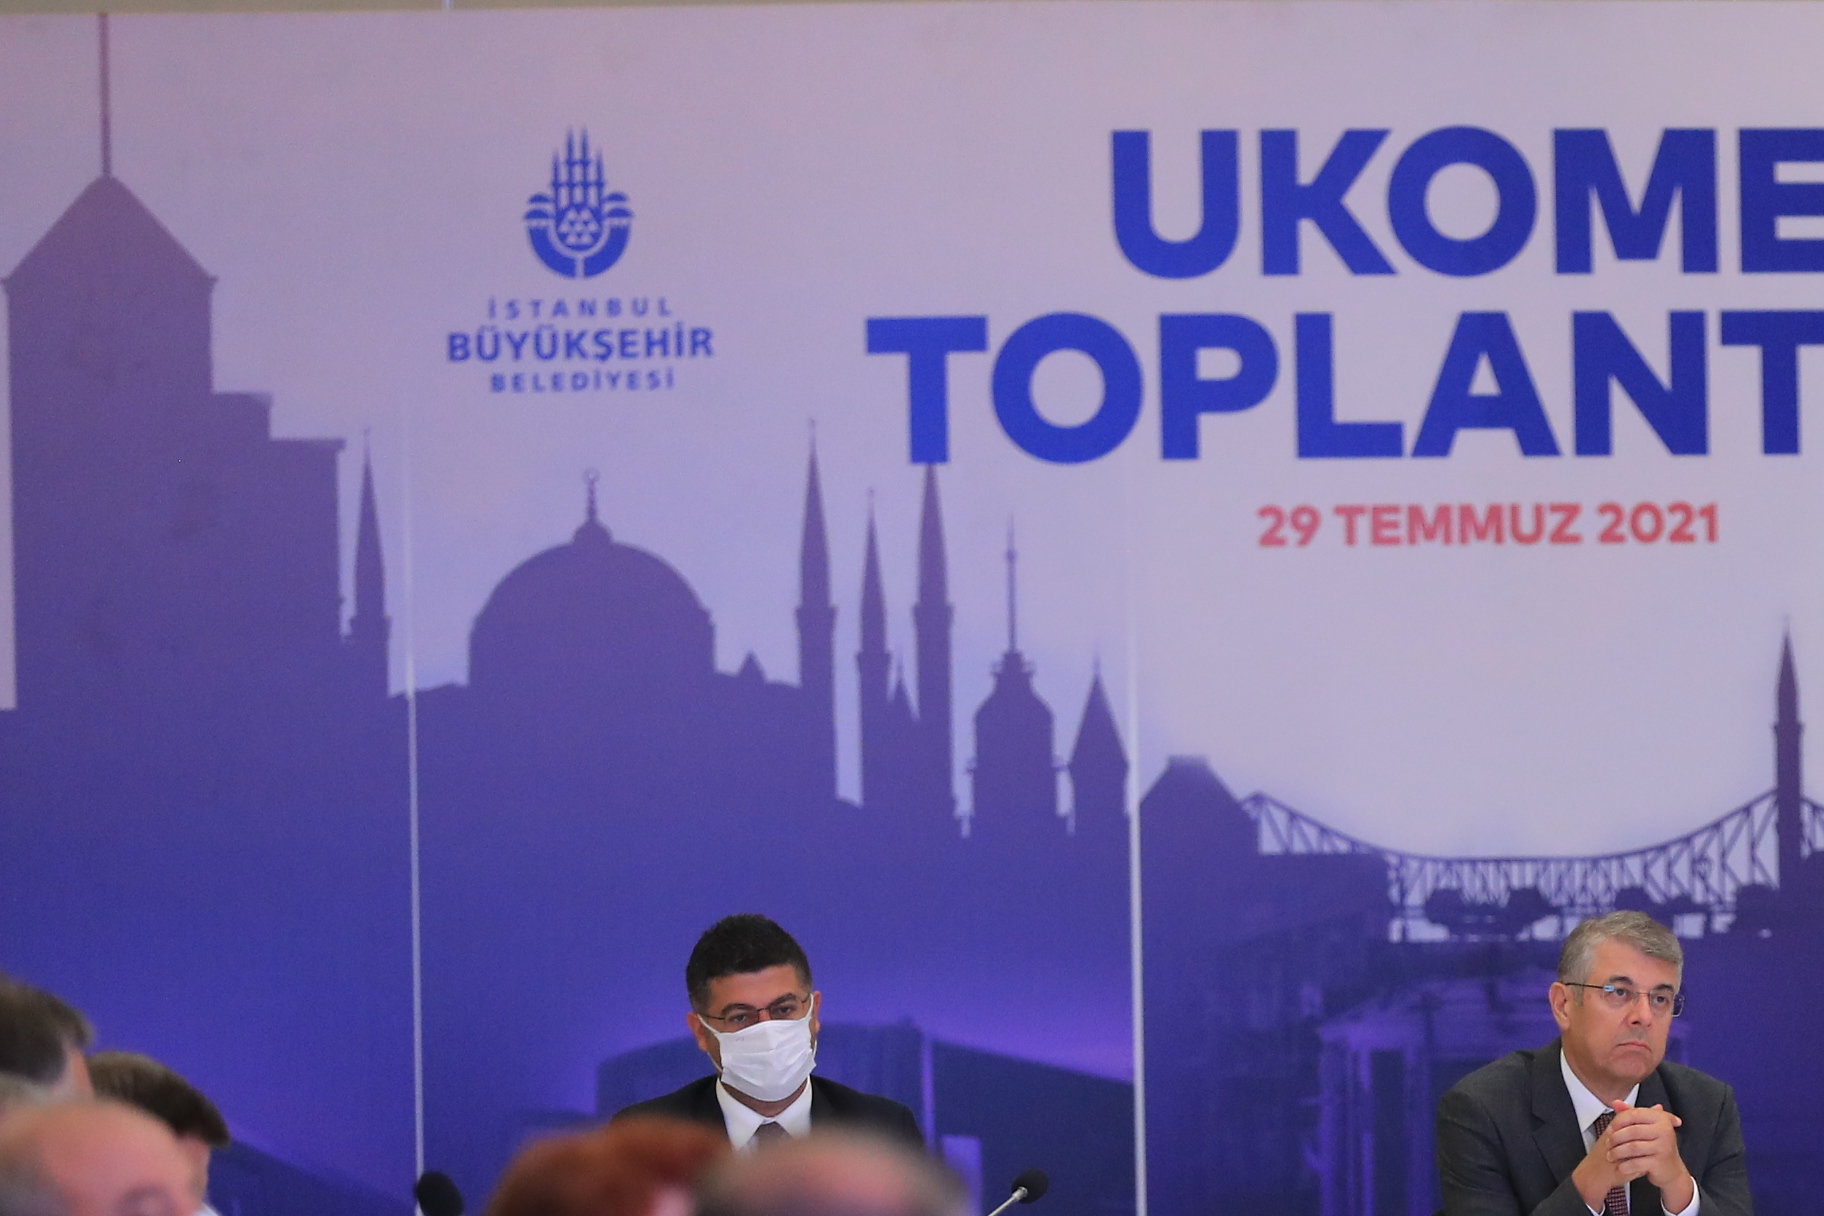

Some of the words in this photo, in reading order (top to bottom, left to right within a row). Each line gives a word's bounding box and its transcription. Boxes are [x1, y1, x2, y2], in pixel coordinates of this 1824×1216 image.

[488, 296, 671, 320] İSTANBUL
[446, 321, 715, 363] BÜYÜKŞEHİR
[490, 366, 675, 393] BELEDİYESİ
[1257, 505, 1322, 548] 29
[1334, 502, 1583, 547] TEMMUZ
[1597, 501, 1720, 545] 2021
